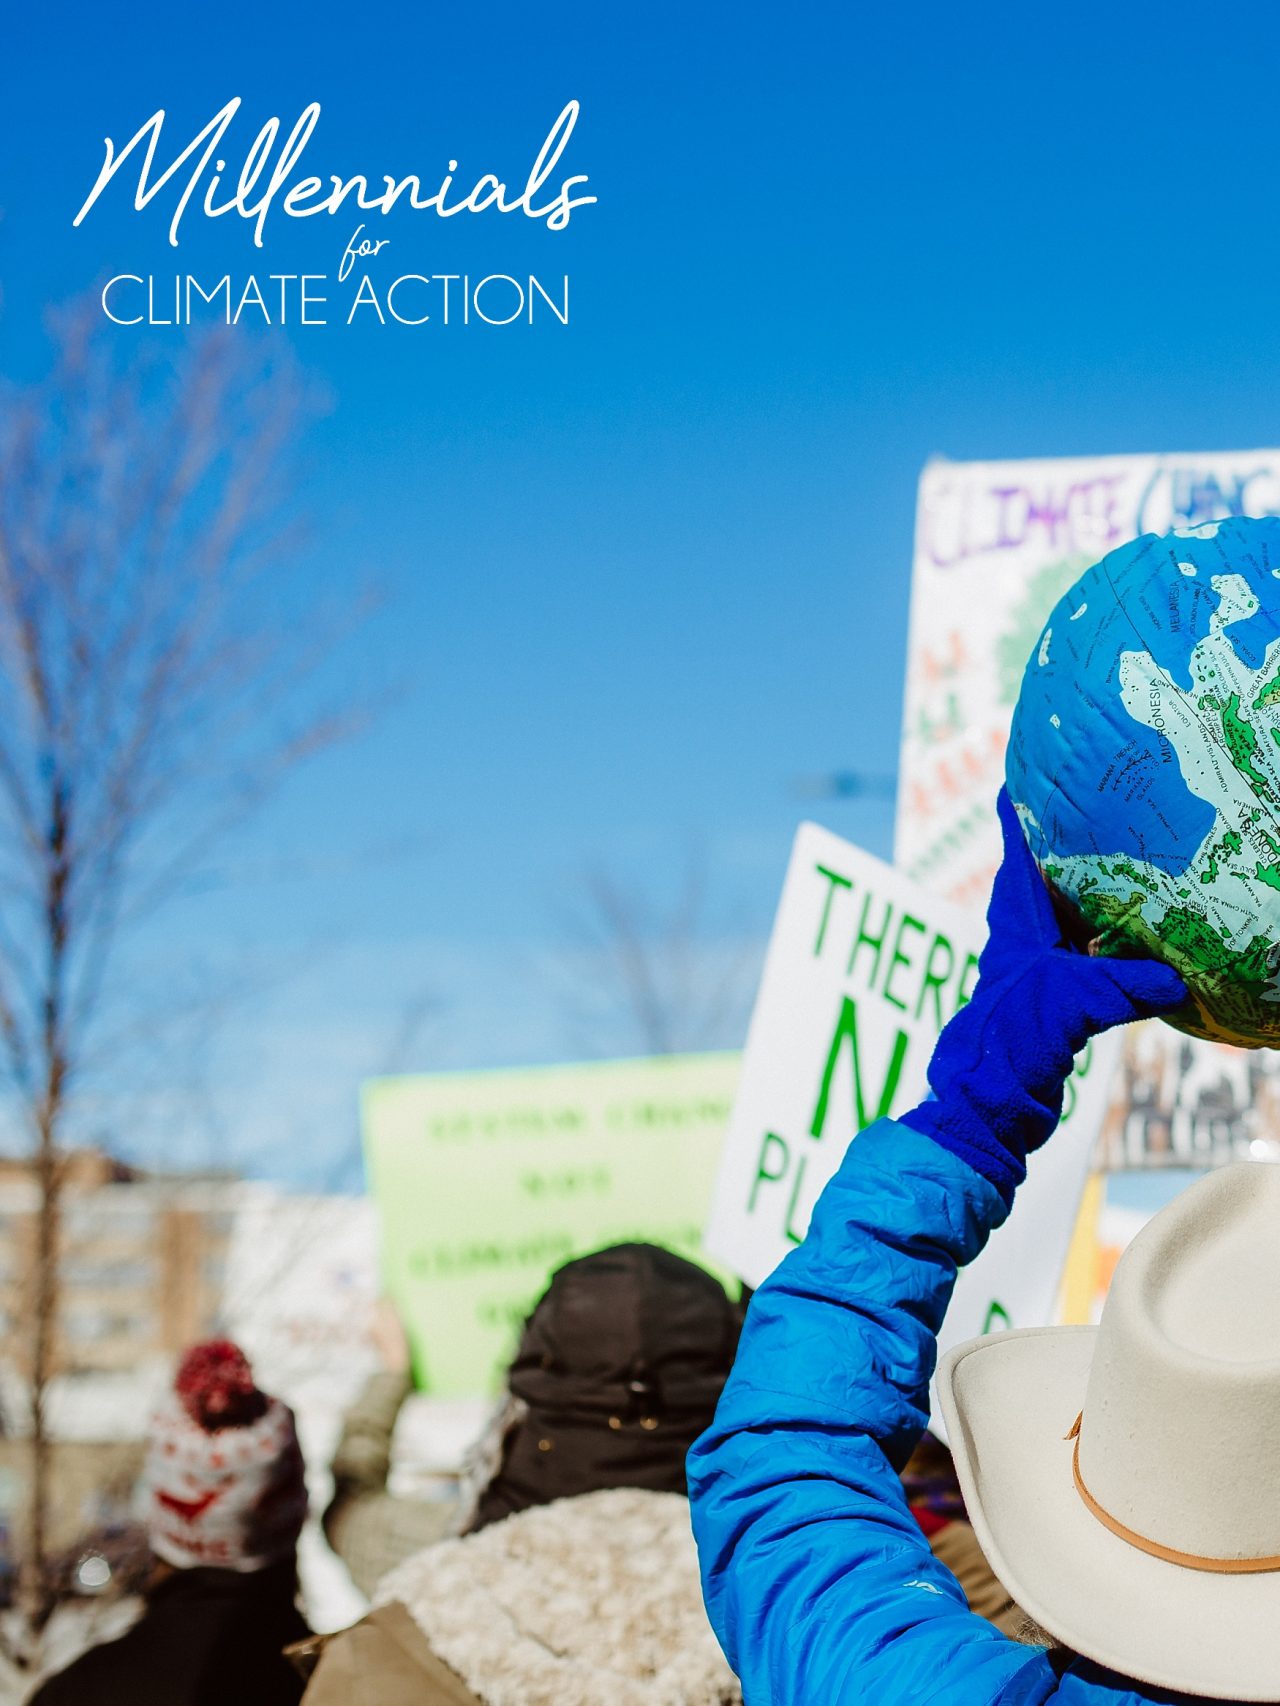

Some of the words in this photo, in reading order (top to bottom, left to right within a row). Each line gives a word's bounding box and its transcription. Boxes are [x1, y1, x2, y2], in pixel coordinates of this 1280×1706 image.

[1168, 580, 1182, 633] MELANESIA
[1208, 649, 1218, 665] SEA
[1218, 651, 1239, 686] PENINSULA
[1212, 663, 1231, 695] SOLOMON
[1246, 674, 1265, 699] GREAT
[1149, 677, 1172, 763] MICRONESIA
[1168, 699, 1192, 729] EQUATOR
[1242, 703, 1254, 722] CAPE
[1252, 710, 1261, 725] SEA
[1197, 723, 1215, 755] ISLANDS
[1098, 763, 1116, 793] MARIANA
[1113, 739, 1138, 762] TRENCH
[1209, 752, 1230, 794] ADMIRALTY
[1265, 761, 1276, 776] SEA
[1197, 826, 1218, 865] PHILIPPINES
[1247, 836, 1267, 864] CELEBES
[1225, 860, 1239, 871] SEA
[1190, 882, 1209, 905] LUZON
[1208, 895, 1220, 904] SEA
[1220, 898, 1241, 912] CHINA
[1240, 878, 1263, 908] PALAWAN
[1236, 915, 1254, 938] TONKIN
[1239, 907, 1260, 922] SOUTH
[807, 994, 910, 1140] N
